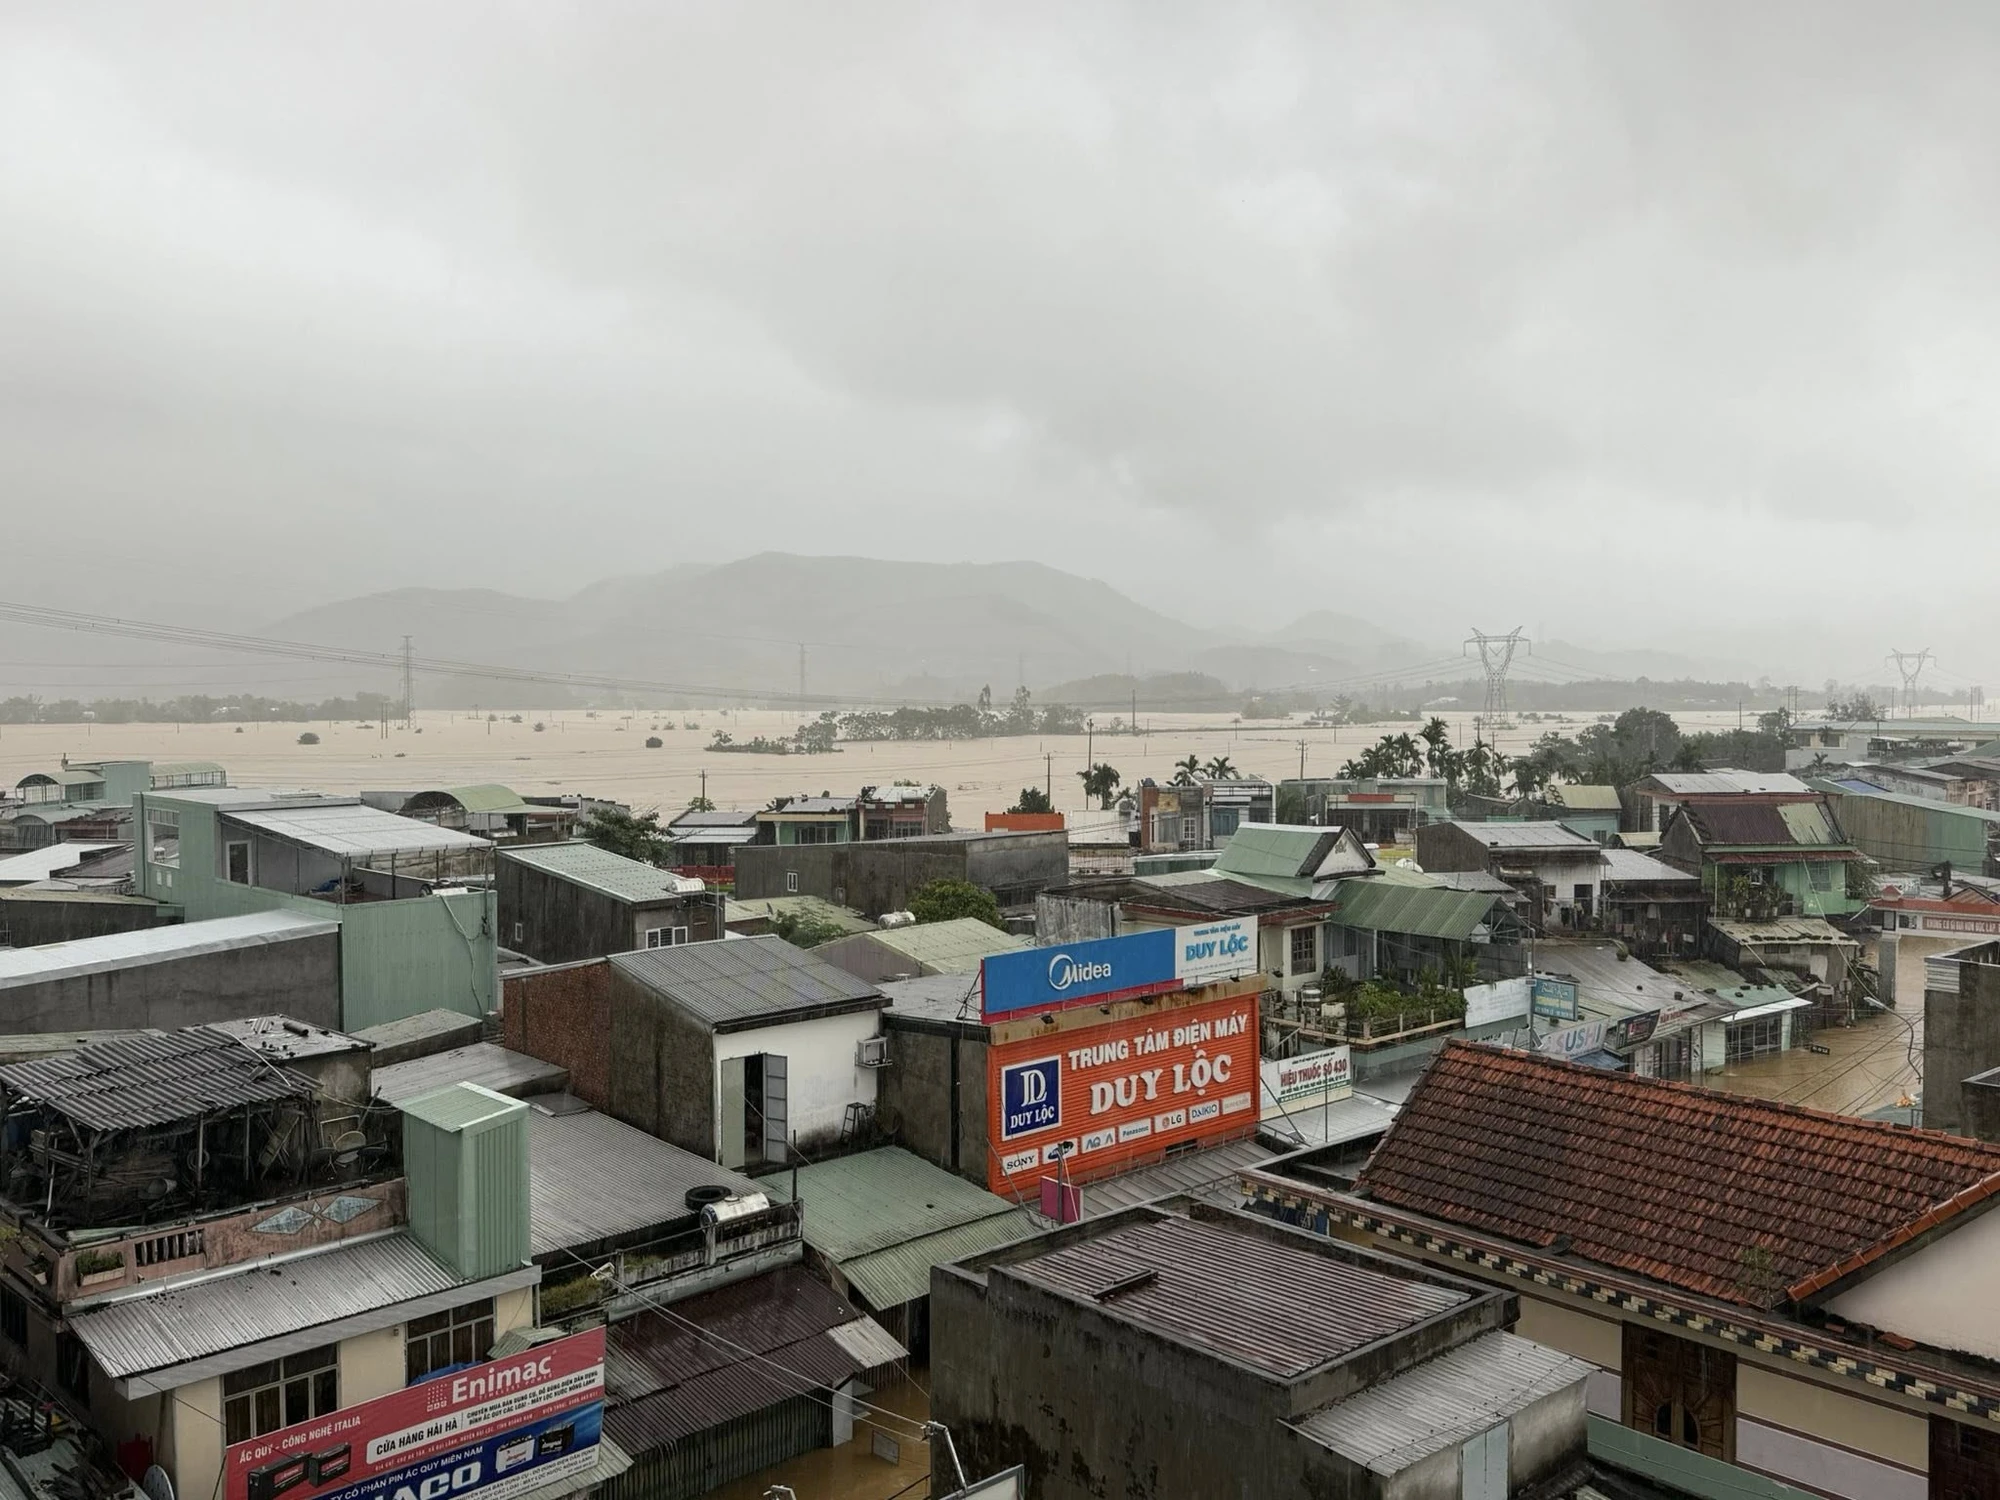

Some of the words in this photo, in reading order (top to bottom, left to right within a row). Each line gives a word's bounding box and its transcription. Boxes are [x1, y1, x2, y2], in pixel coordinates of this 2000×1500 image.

[1186, 941, 1216, 961] DUY
[1220, 933, 1248, 958] LỘC
[1049, 954, 1111, 990] Midea
[1068, 1039, 1129, 1070] TRUNG
[1133, 1028, 1169, 1056] TÂM
[1173, 1018, 1211, 1050] ĐIỆN
[1215, 1010, 1248, 1039] MÁY
[1090, 1068, 1163, 1115] DUY
[1172, 1049, 1232, 1096] LỘC
[1298, 1061, 1321, 1082] THUỐC
[1323, 1058, 1332, 1076] SỐ
[1333, 1058, 1347, 1073] 430
[1010, 1111, 1033, 1129] DUY
[1035, 1104, 1055, 1124] LỘC
[1171, 1114, 1182, 1125] LG
[1191, 1104, 1217, 1118] DAIKIO
[1122, 1126, 1149, 1137] Panasonic
[1006, 1155, 1035, 1170] SONY
[453, 1356, 552, 1403] Enimac
[489, 1402, 501, 1412] MUA
[282, 1434, 307, 1449] CÔNG
[309, 1424, 332, 1440] NGHỆ
[334, 1416, 361, 1432] ITALIA
[376, 1440, 396, 1455] CỬA
[399, 1430, 424, 1448] HÀNG
[427, 1422, 442, 1438] HẢI
[445, 1417, 457, 1432] HÀ
[345, 1486, 359, 1500] CỔ
[361, 1478, 387, 1494] PHẦN
[389, 1473, 404, 1485] PIN
[420, 1462, 440, 1474] QUY
[441, 1453, 463, 1466] MIỀN
[464, 1446, 483, 1458] NAM
